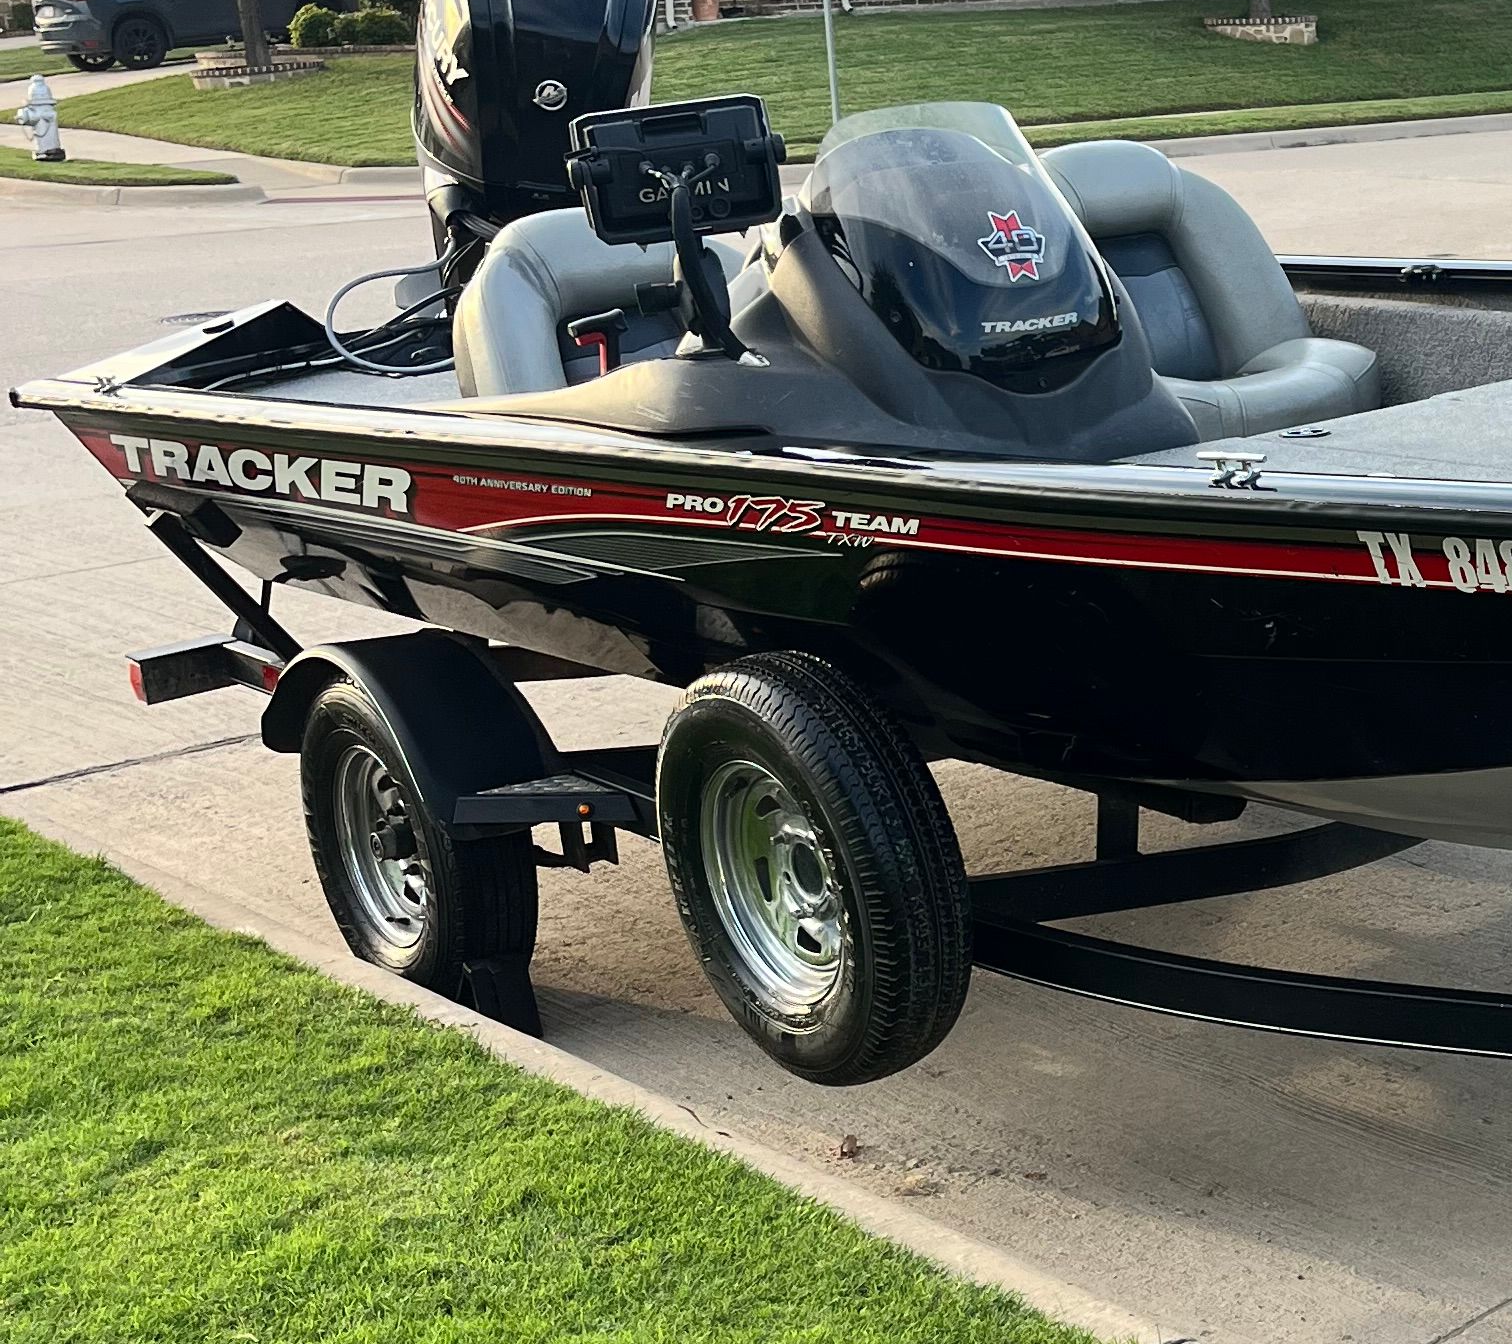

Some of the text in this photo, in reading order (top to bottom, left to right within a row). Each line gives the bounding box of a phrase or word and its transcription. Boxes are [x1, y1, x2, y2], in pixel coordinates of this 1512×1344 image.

[981, 311, 1078, 333] TRACKER
[110, 433, 412, 513] TRACKER
[452, 474, 592, 498] 40TH ANNIVERSARY EDITION
[666, 493, 920, 535] PRO 175 TEAM
[1356, 530, 1427, 588] TX
